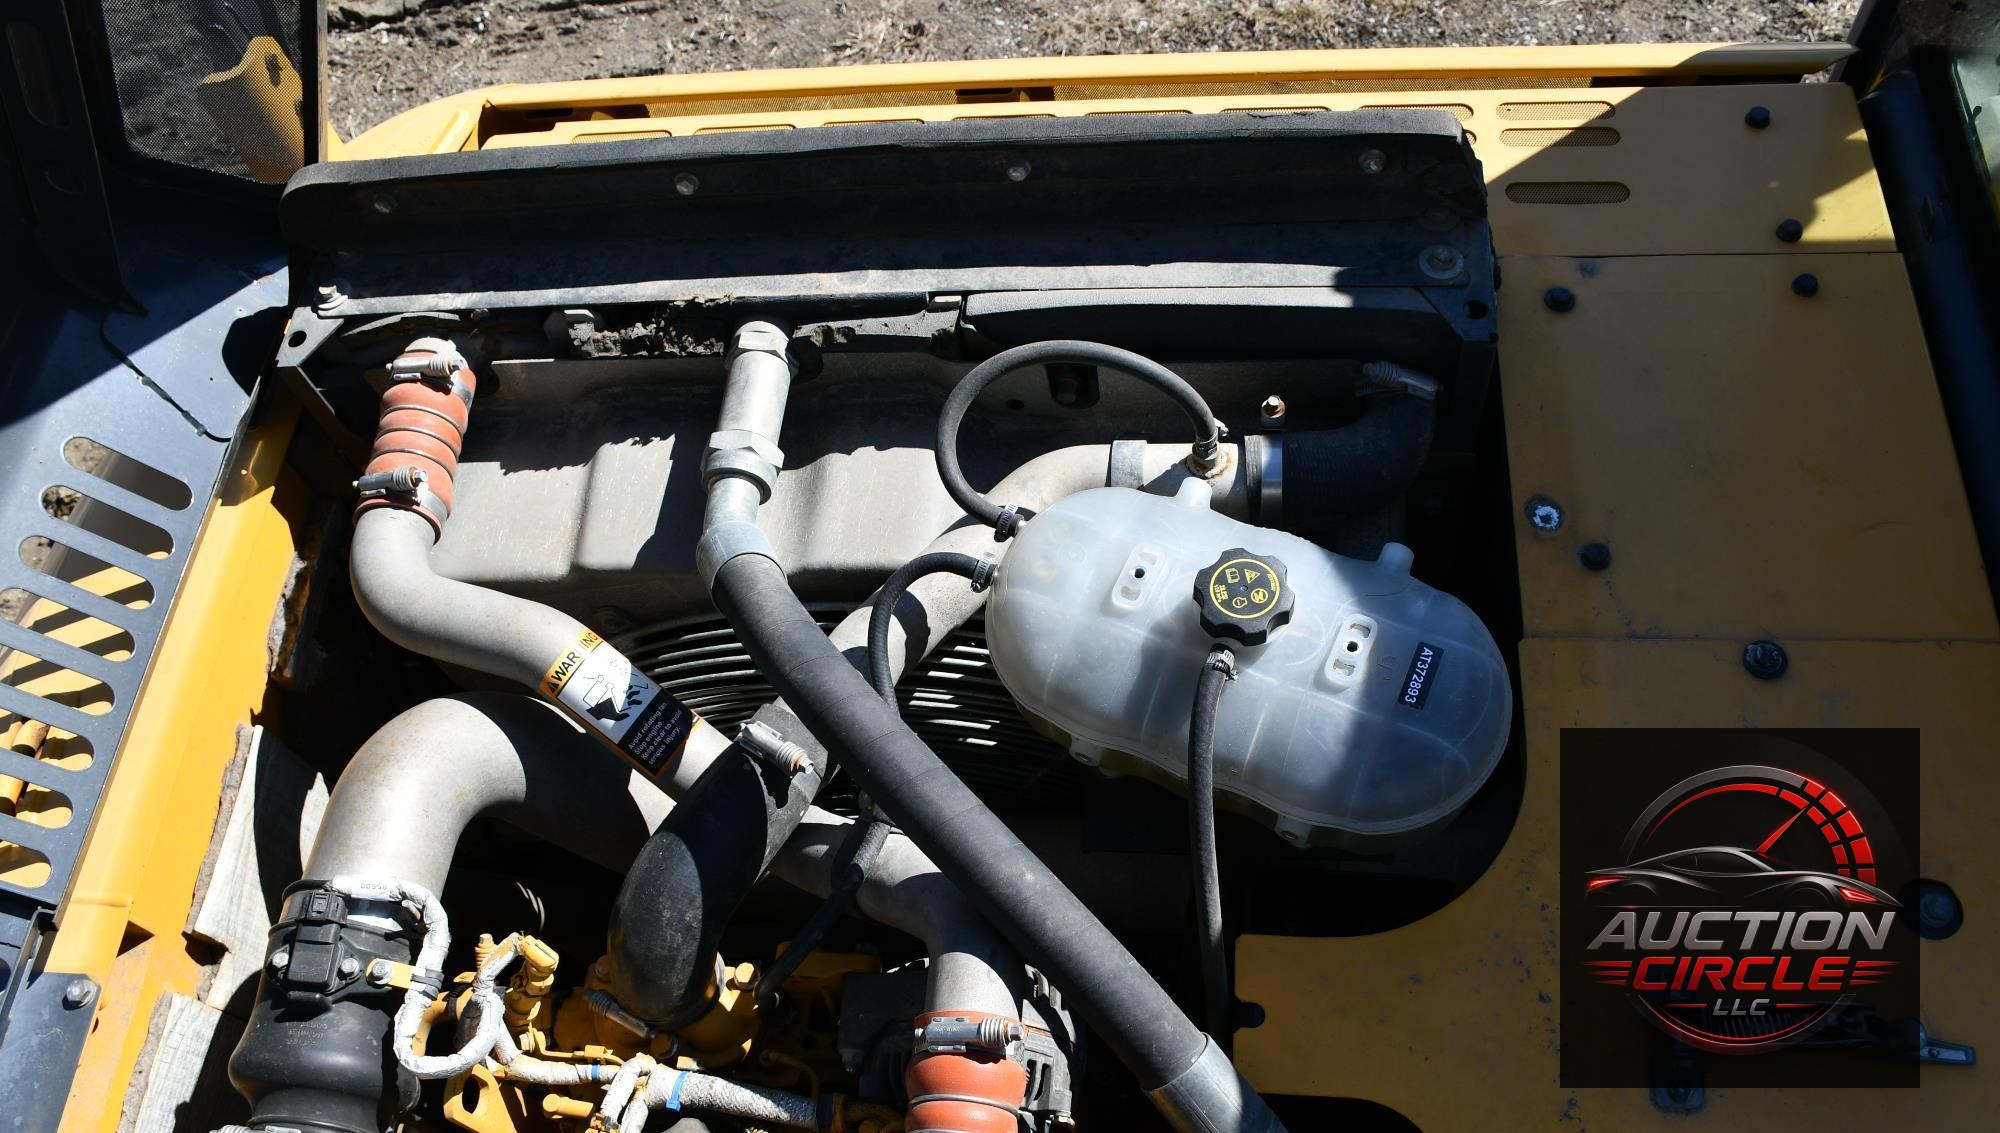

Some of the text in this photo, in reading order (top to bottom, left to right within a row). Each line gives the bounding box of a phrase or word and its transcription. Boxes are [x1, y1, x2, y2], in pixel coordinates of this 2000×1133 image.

[1404, 646, 1434, 703] AT372893
[628, 732, 643, 750] Avoid
[641, 710, 662, 734] rotating
[634, 741, 647, 755] Stop
